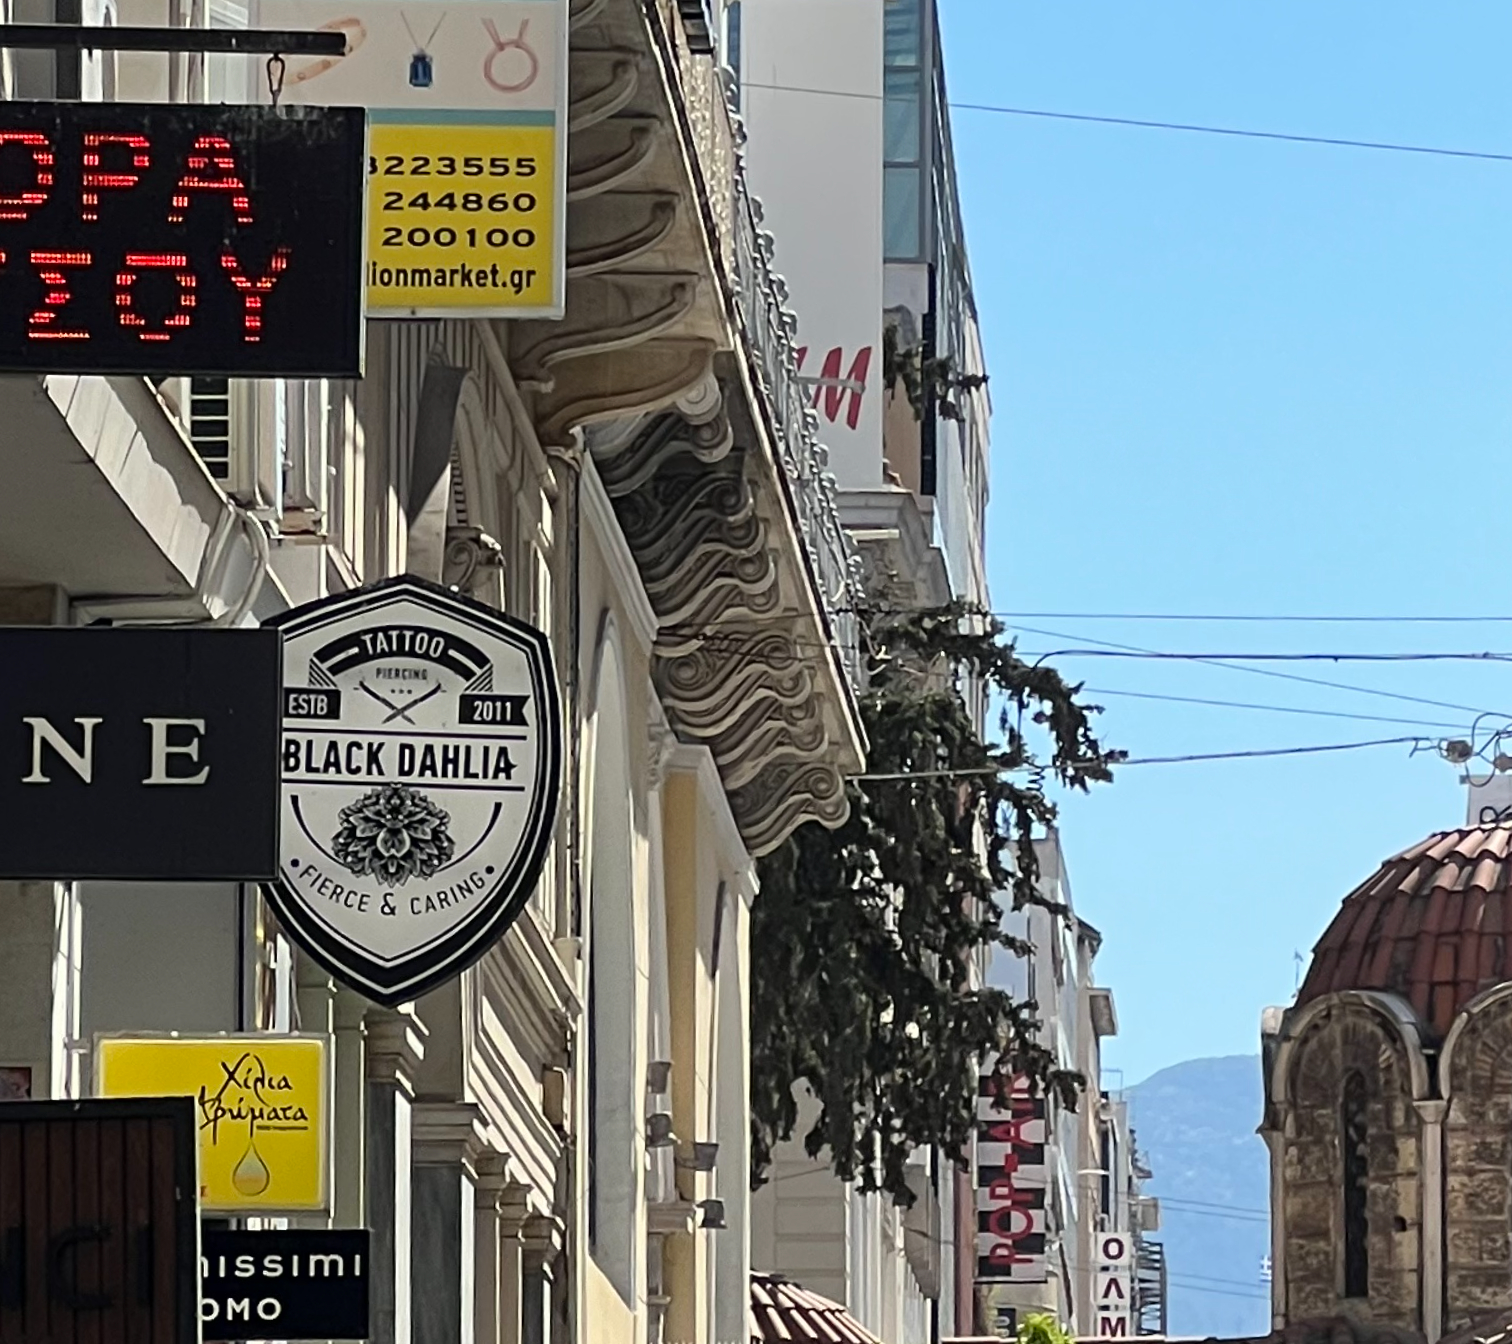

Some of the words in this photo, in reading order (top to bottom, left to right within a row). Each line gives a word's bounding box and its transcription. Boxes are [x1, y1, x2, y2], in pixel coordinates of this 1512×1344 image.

[383, 192, 536, 212] 244860
[382, 227, 535, 248] 200100
[0, 246, 292, 342] ΣΟΥ
[362, 630, 445, 657] TATTOO
[375, 667, 428, 681] PIERCING
[289, 693, 328, 715] ESTB
[473, 701, 512, 721] 2011
[283, 738, 385, 776] BLACK
[399, 742, 517, 780] DAHLIA
[300, 864, 370, 912] FIERCE
[380, 892, 396, 916] &
[411, 872, 485, 915] CARING
